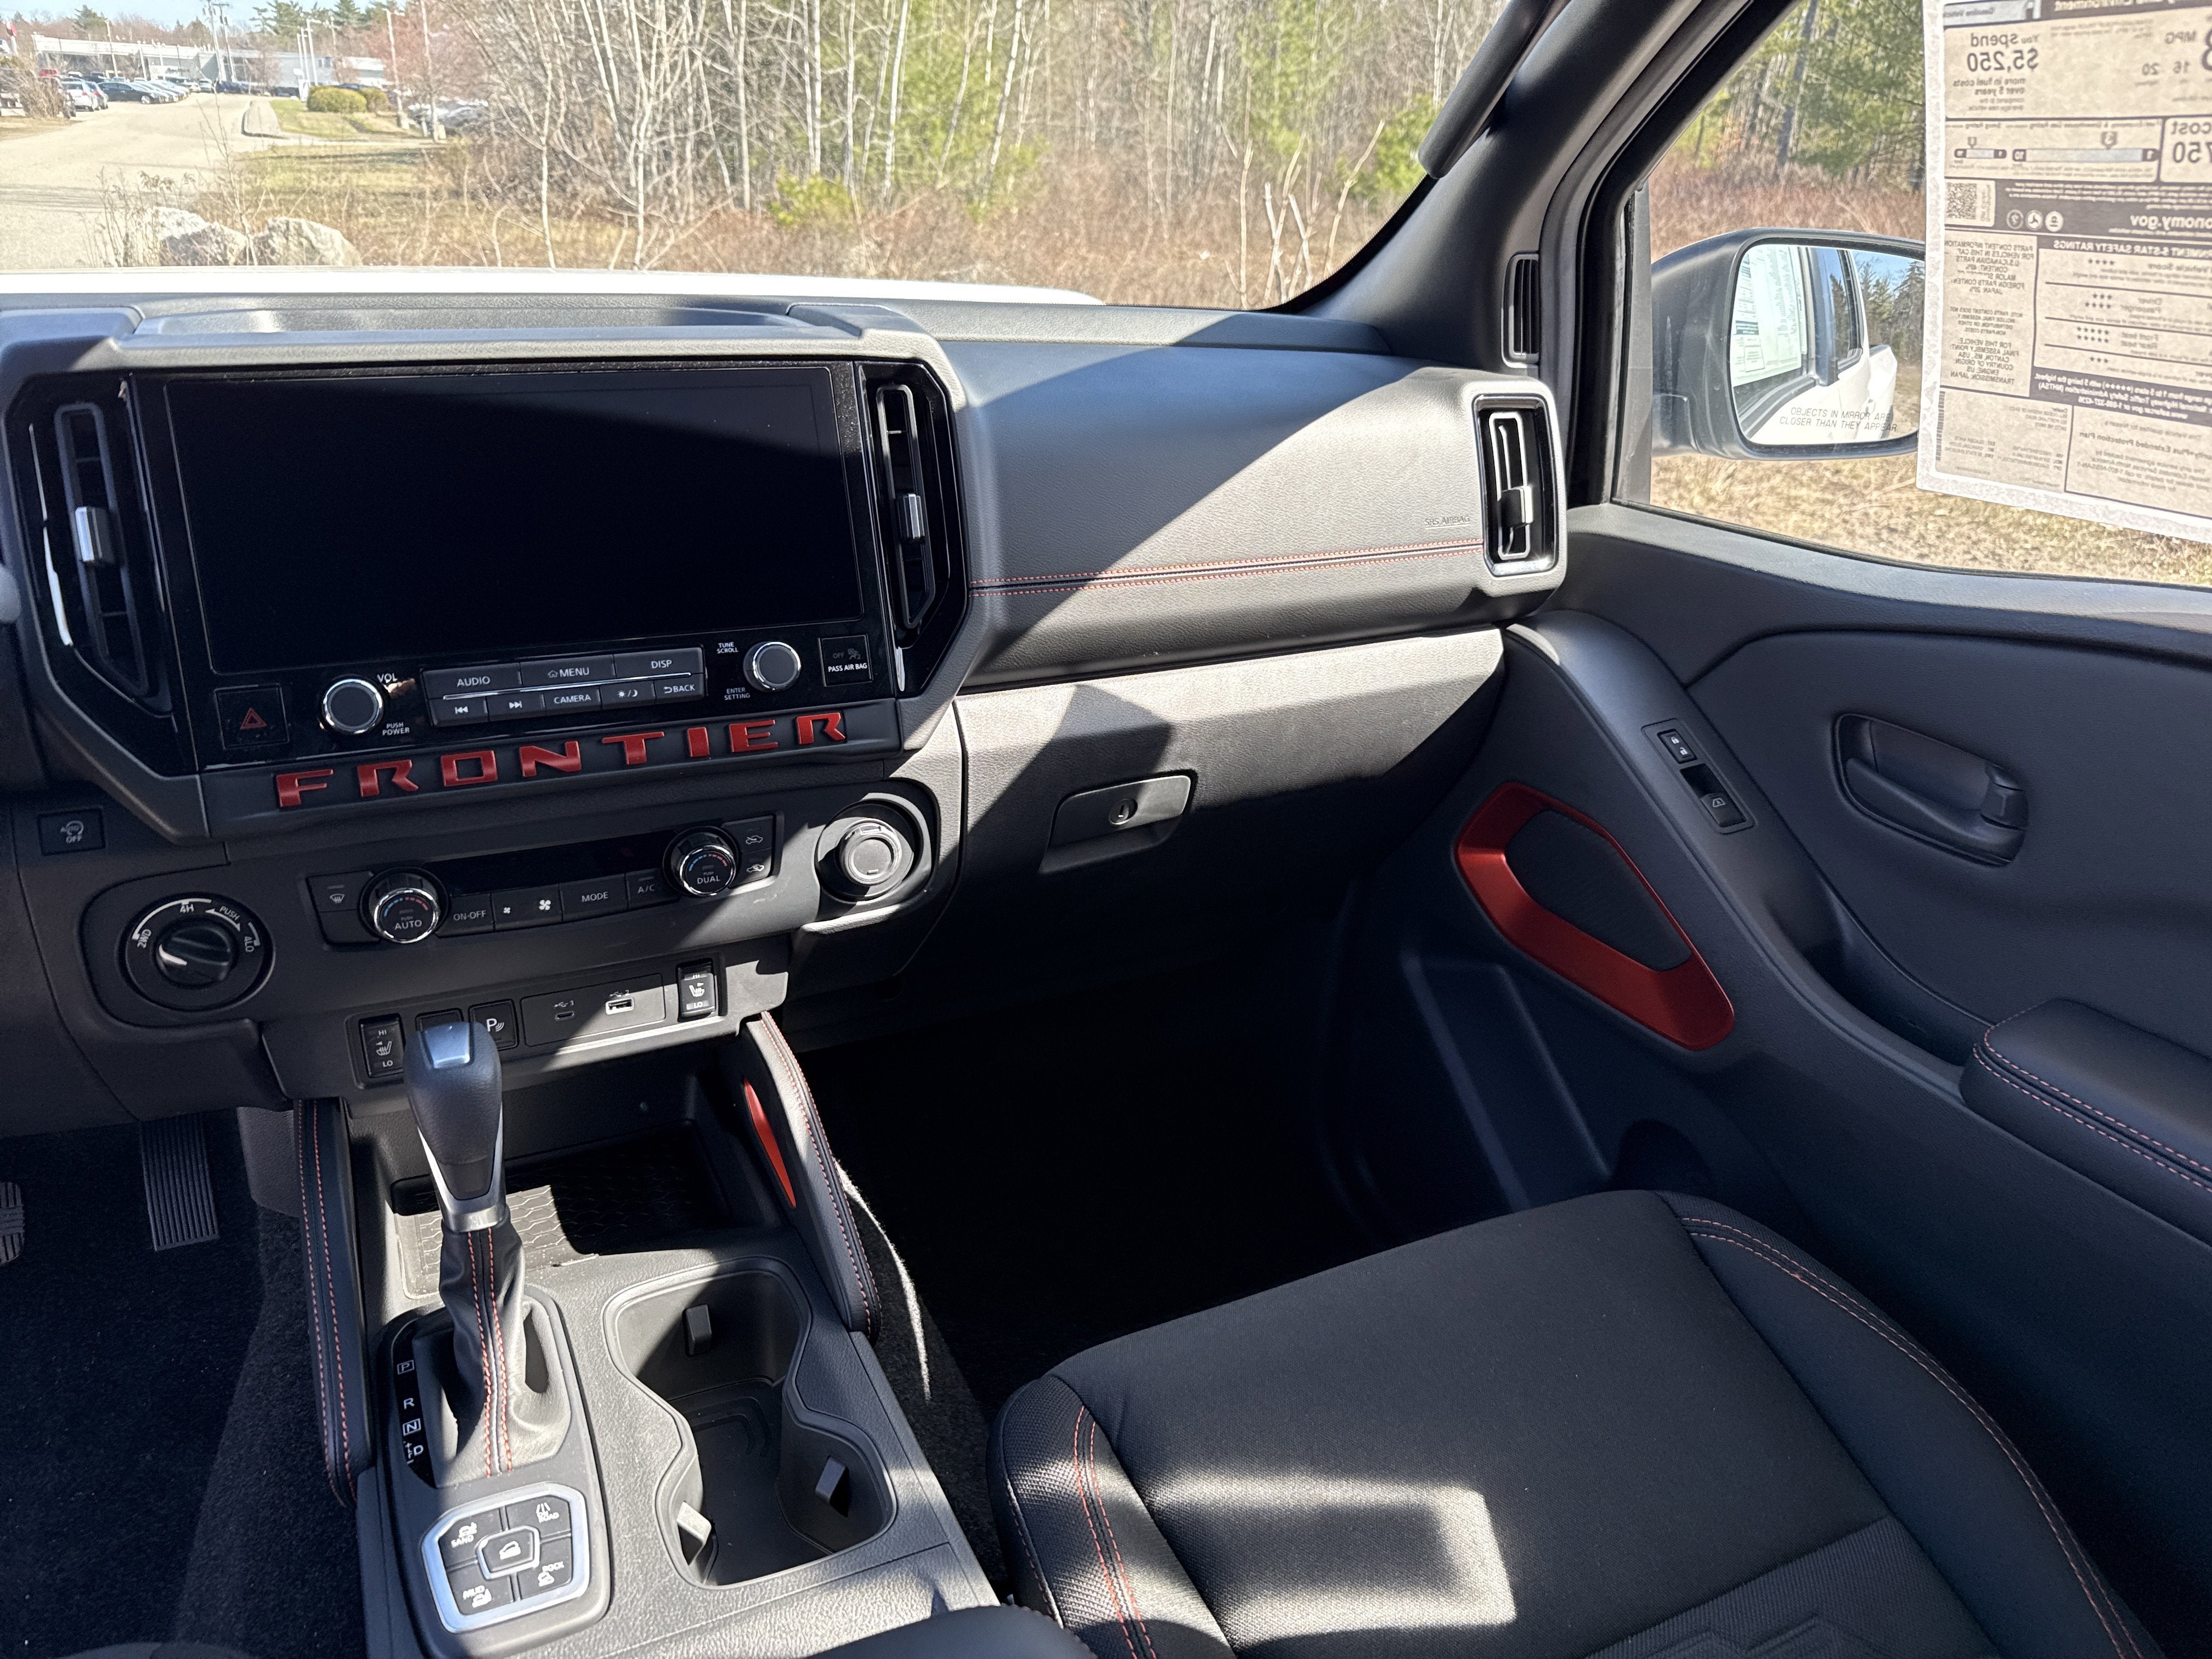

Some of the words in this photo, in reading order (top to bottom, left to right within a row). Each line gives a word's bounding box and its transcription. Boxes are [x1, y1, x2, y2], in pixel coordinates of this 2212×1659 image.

[1791, 407, 1827, 417] OBJECTS
[1831, 409, 1838, 417] IN
[1842, 410, 1870, 421] MIRROR
[1874, 412, 1891, 421] ARE
[1780, 416, 1812, 426] CLOSER
[1816, 419, 1836, 428] THAN
[1841, 421, 1859, 431] THEY
[1863, 422, 1897, 432] APPEAR
[717, 646, 738, 654] SCROLL
[651, 659, 672, 669] DISP
[559, 667, 590, 678] MENU
[377, 673, 398, 684] VOL
[456, 676, 490, 687] AUDIO
[673, 683, 696, 693] BACK
[554, 694, 591, 704] CAMERA
[724, 691, 751, 701] SETTING
[382, 726, 410, 736] POWER
[386, 721, 404, 730] PUSH
[275, 712, 847, 808] FRONTIER
[66, 834, 83, 844] OFF
[697, 874, 721, 884] DUAL
[638, 883, 656, 894] A/C
[582, 891, 609, 903] MODE
[179, 904, 195, 914] 4H
[219, 906, 241, 921] PUSH
[453, 910, 487, 921] ON-OFF
[394, 919, 422, 930] AUTO
[136, 928, 153, 950] 2WD
[243, 936, 255, 953] 4LO
[401, 1363, 410, 1372] P
[403, 1398, 415, 1409] R
[407, 1420, 417, 1432] N
[414, 1444, 424, 1456] D
[451, 1535, 474, 1548] SAND
[542, 1561, 565, 1572] ROCK
[463, 1585, 485, 1600] MUD
